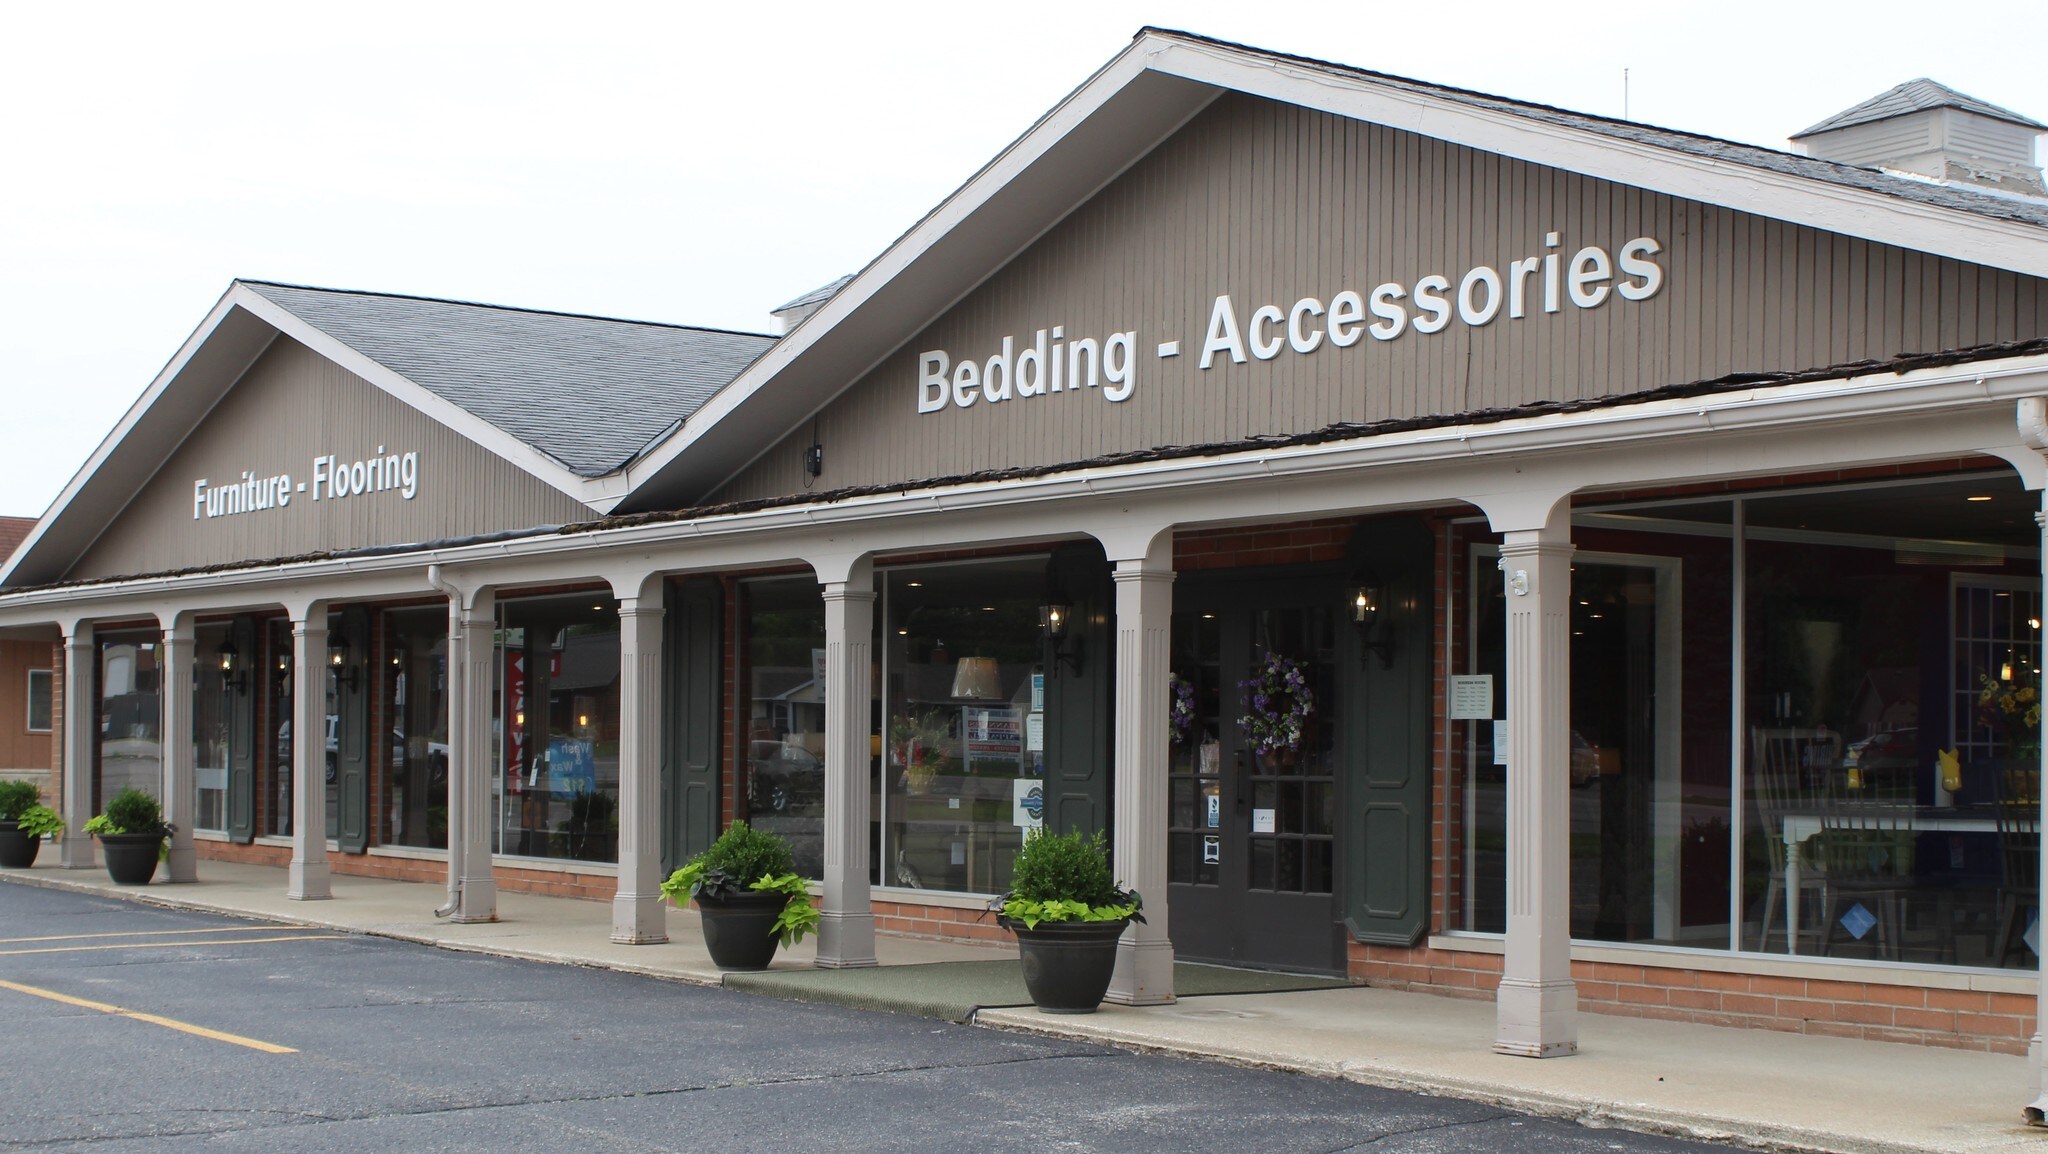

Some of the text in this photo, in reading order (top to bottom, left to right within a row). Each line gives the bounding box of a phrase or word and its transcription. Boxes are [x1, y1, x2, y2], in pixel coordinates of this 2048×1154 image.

[918, 231, 1664, 414] Bedding - Accessories
[194, 444, 418, 519] Furniture - Flooring
